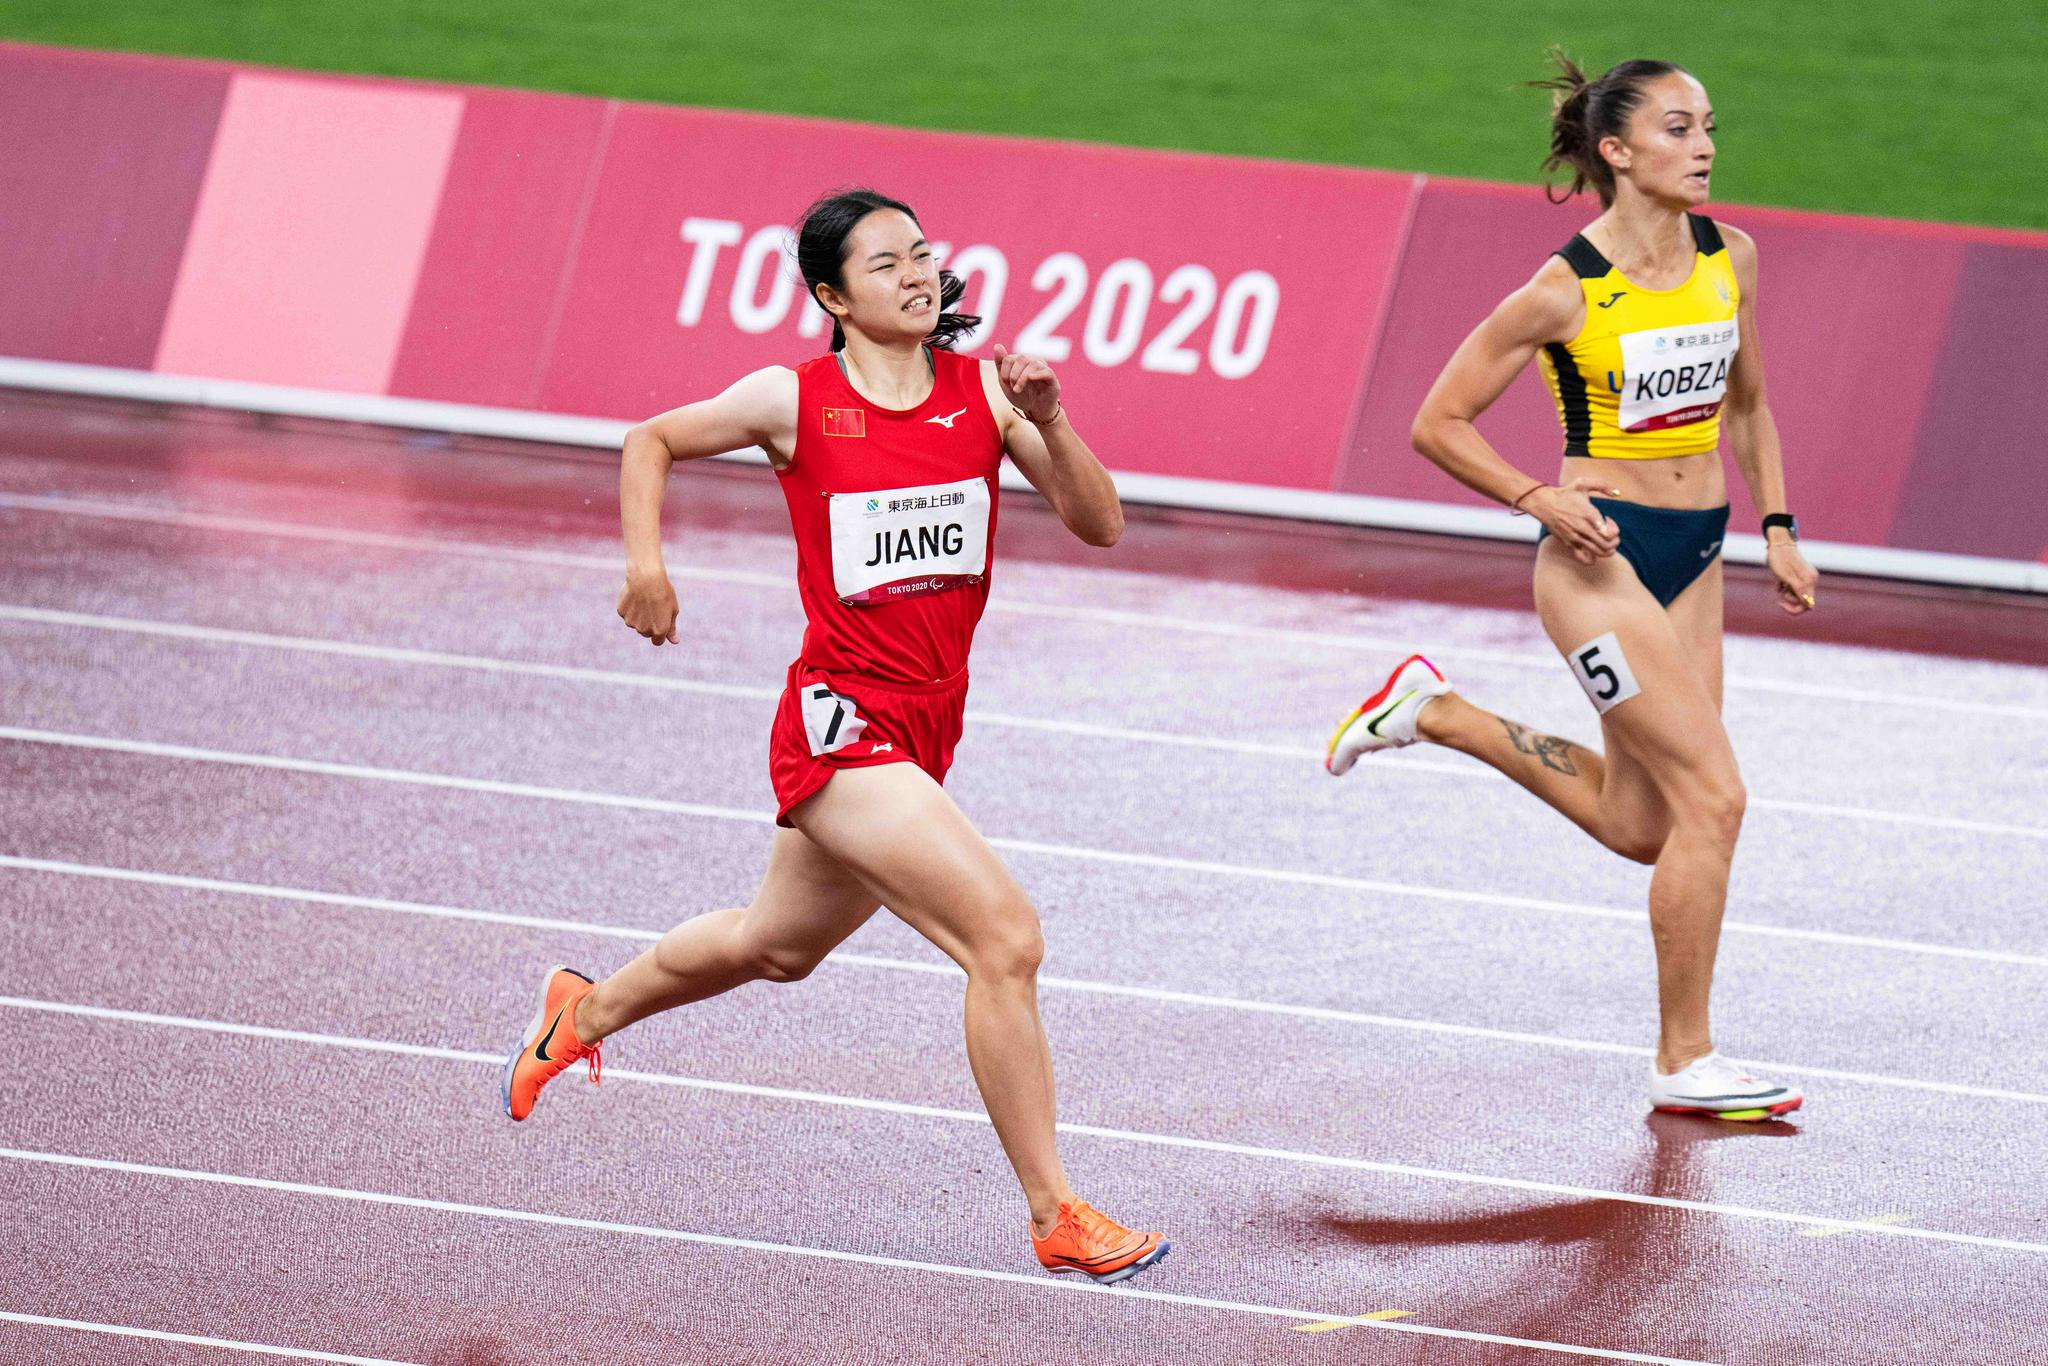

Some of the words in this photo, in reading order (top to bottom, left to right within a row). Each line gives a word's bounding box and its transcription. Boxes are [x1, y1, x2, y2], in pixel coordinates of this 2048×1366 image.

[676, 217, 1008, 353] TOO
[1012, 251, 1280, 379] 2020
[1635, 349, 1736, 401] KOBZA
[888, 492, 965, 513] 東京海上日動
[865, 523, 963, 567] JIANG
[887, 584, 911, 595] TOKYO
[911, 581, 928, 592] 2020
[1578, 645, 1620, 701] 5
[813, 688, 846, 747] 7
